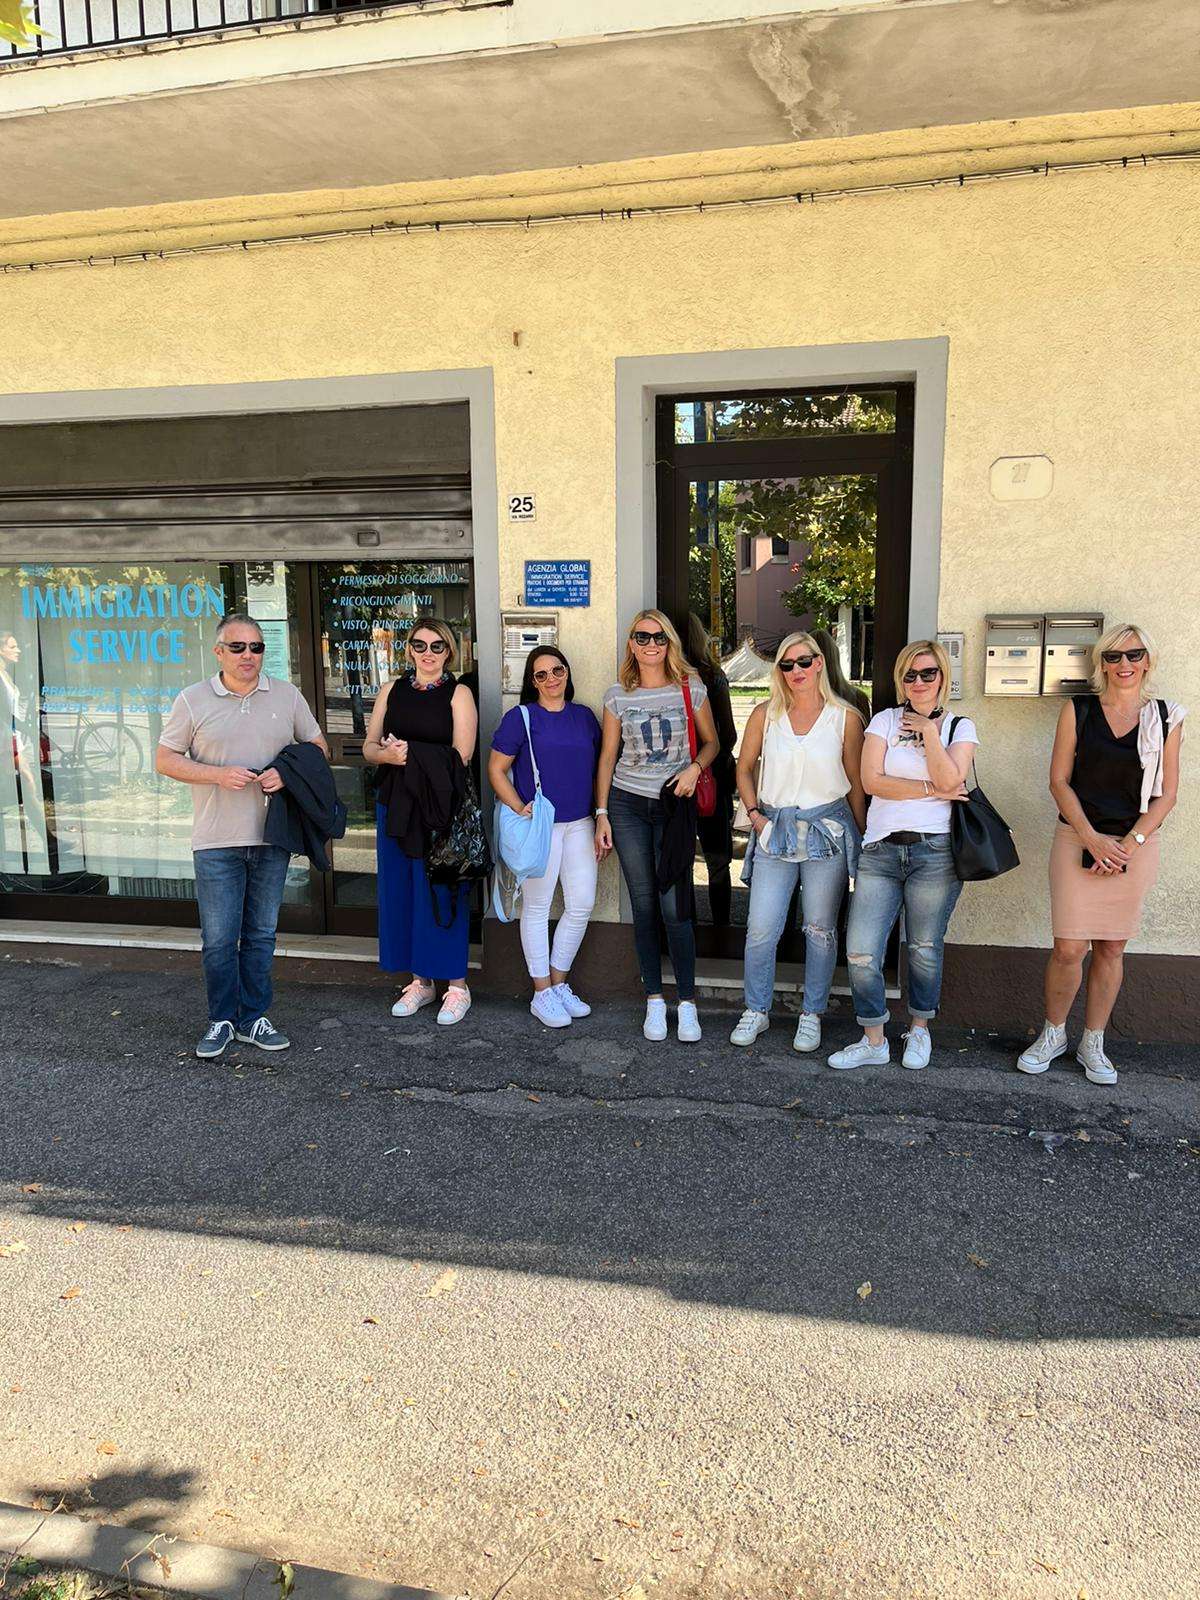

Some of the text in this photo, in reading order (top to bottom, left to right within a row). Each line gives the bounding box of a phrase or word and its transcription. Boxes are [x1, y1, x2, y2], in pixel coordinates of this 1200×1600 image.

[511, 496, 533, 513] 25
[527, 564, 588, 573] AGENZIA GLOBAL
[339, 573, 459, 586] PERMESSO DI SOGGIORNO
[21, 582, 225, 619] IMMIGRATION
[340, 595, 433, 607] RICONGIUNGIMENTI
[341, 619, 415, 630] VISTO D'INGRES
[70, 630, 185, 664] SERVICE
[342, 640, 370, 651] CARTA
[345, 684, 381, 695] CITTAD
